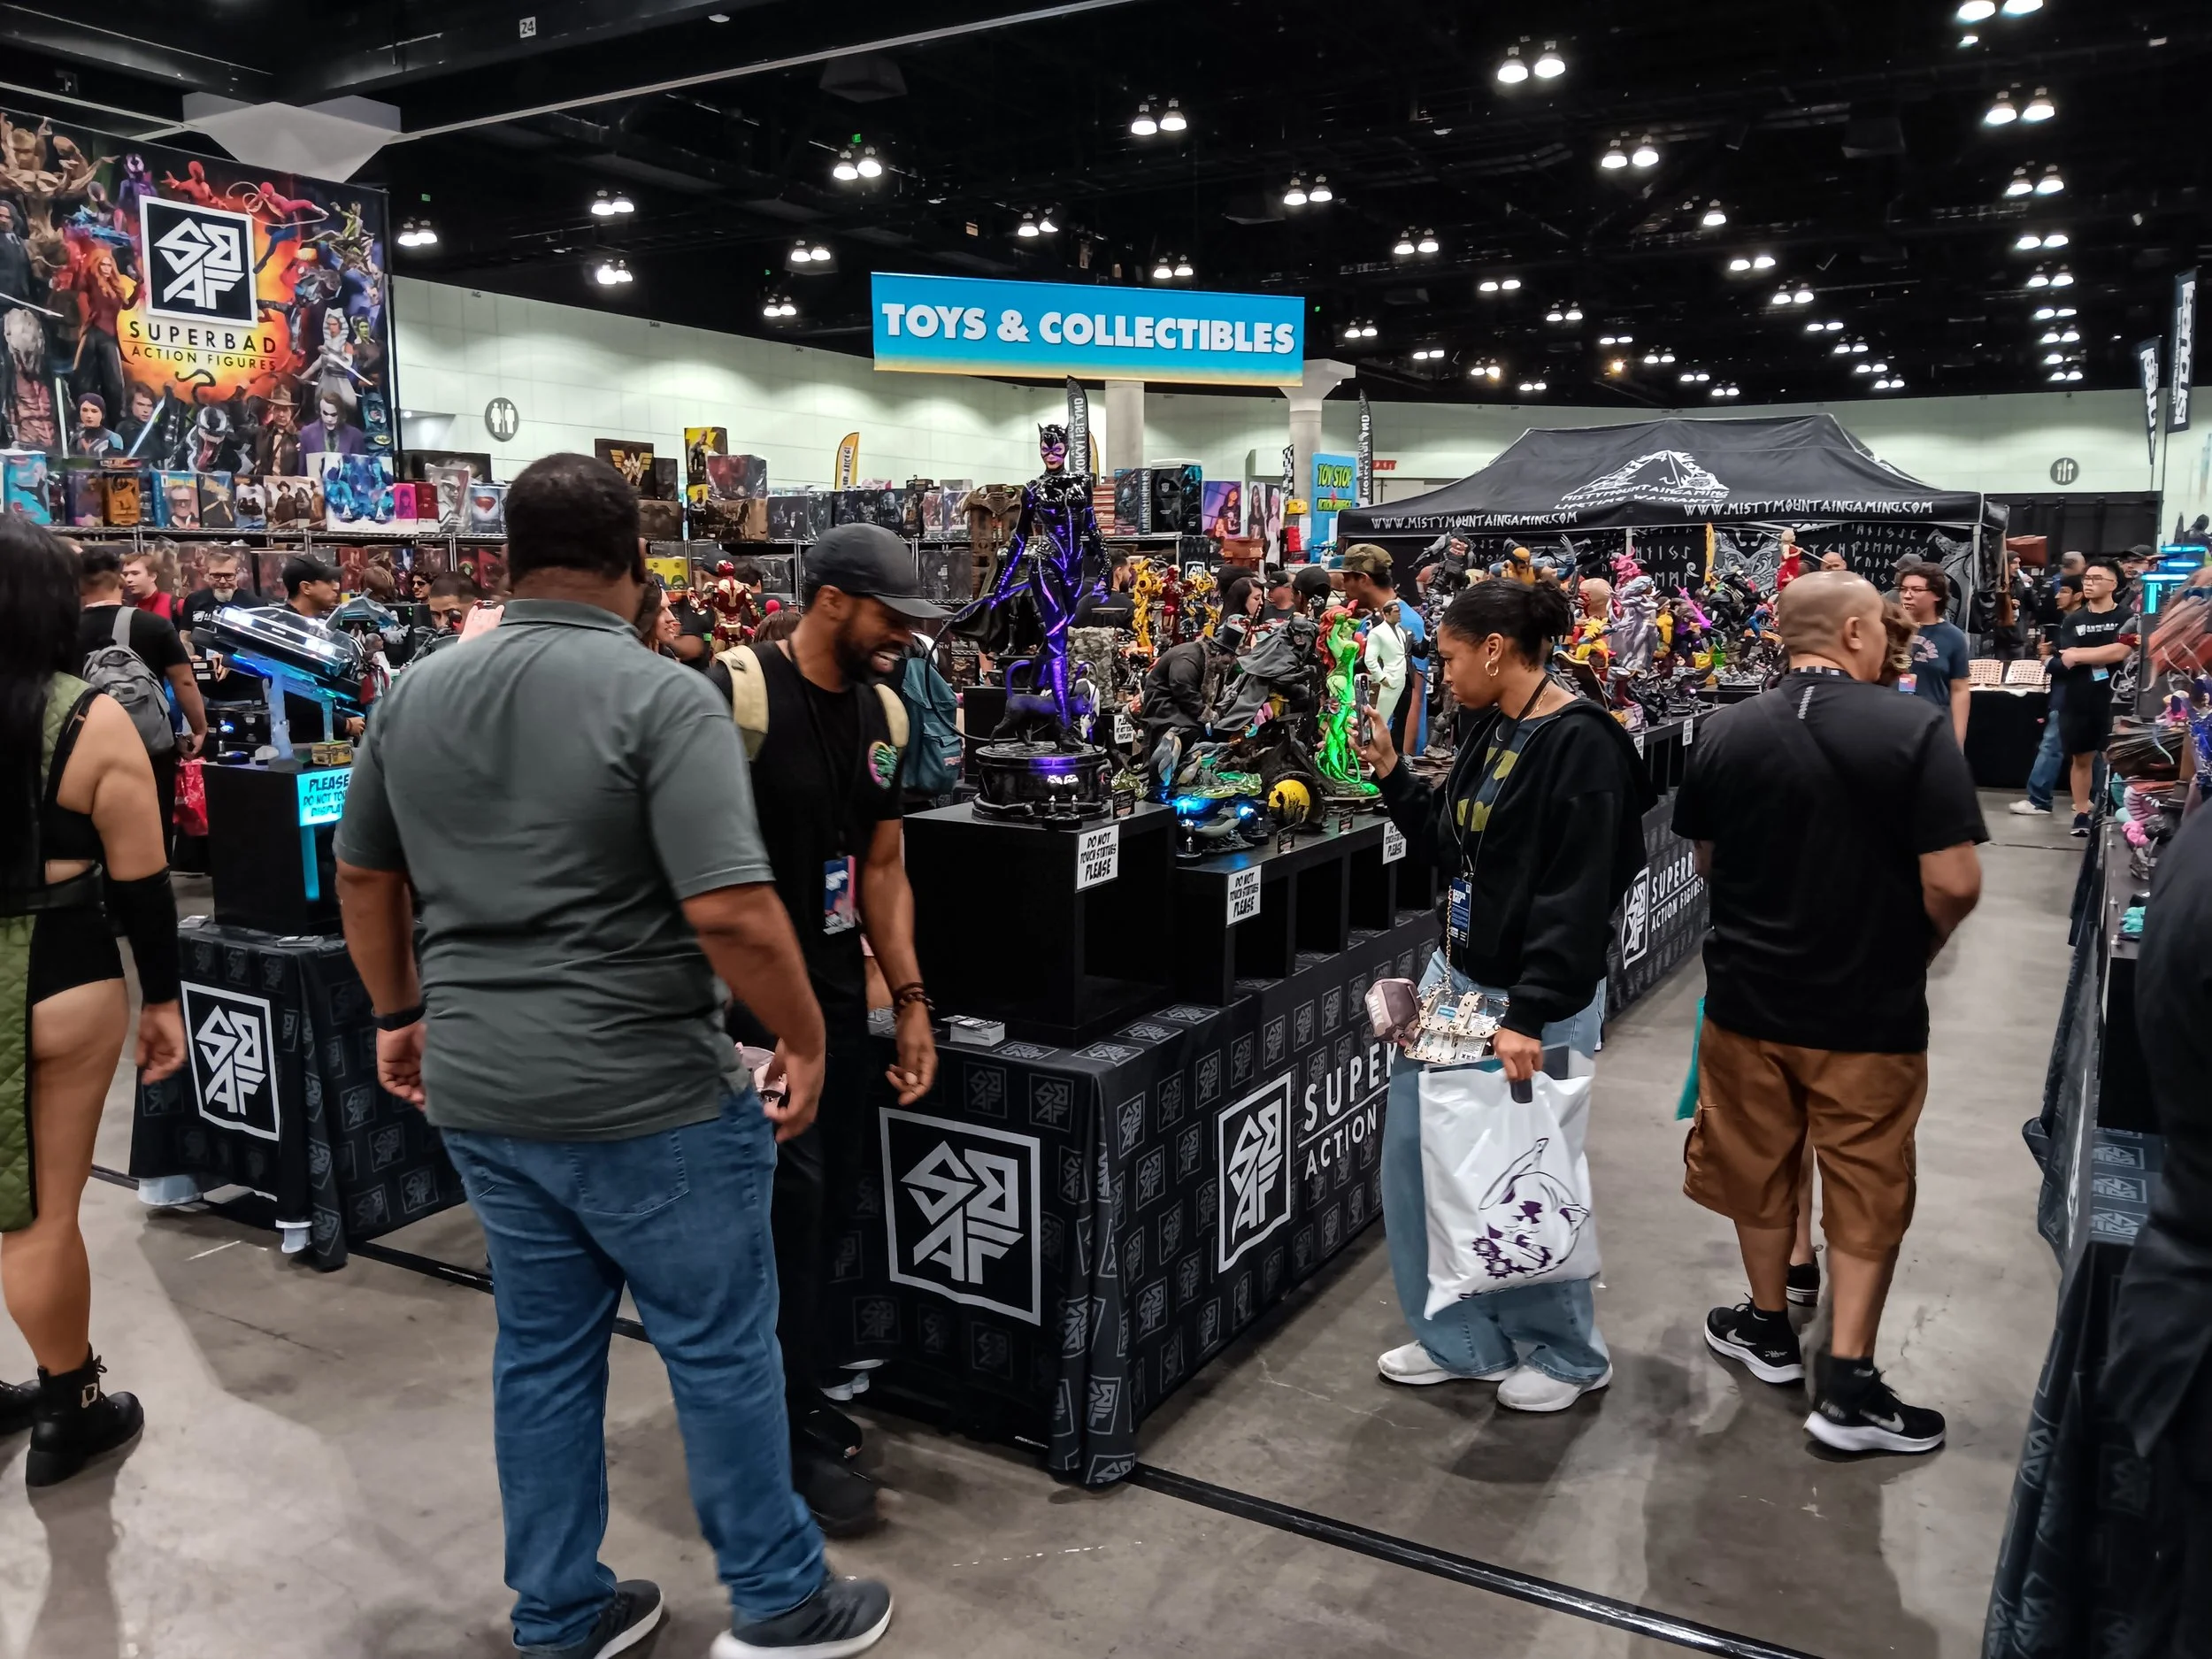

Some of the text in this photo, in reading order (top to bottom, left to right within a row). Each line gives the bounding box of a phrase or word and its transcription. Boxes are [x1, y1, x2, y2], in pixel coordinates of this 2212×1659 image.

[521, 20, 534, 35] 24
[129, 320, 277, 354] SUPERBAD
[881, 303, 1295, 355] TOYS & COLLECTIBLES
[132, 346, 277, 371] ACTION FIGURES
[1317, 464, 1333, 488] TOY
[1333, 465, 1352, 488] STOP
[1684, 500, 1933, 517] WWW.MISTYMOUNTAINGAMING.COM
[1371, 511, 1578, 530] WWW.MISTYMOUNTAINGAMING.COM
[309, 773, 349, 793] PLEASE
[303, 790, 347, 806] DO NOT TOU
[311, 803, 343, 817] DISPLA
[1087, 832, 1111, 849] DO NOT
[1079, 849, 1096, 864] TOUCH
[1085, 857, 1112, 882] PLEASE
[1234, 872, 1255, 888] DO NOT
[1651, 851, 1696, 903] SUPERB
[1233, 895, 1255, 918] PLEASE
[1651, 897, 1678, 933] ACTION
[1304, 1103, 1377, 1181] ACTION
